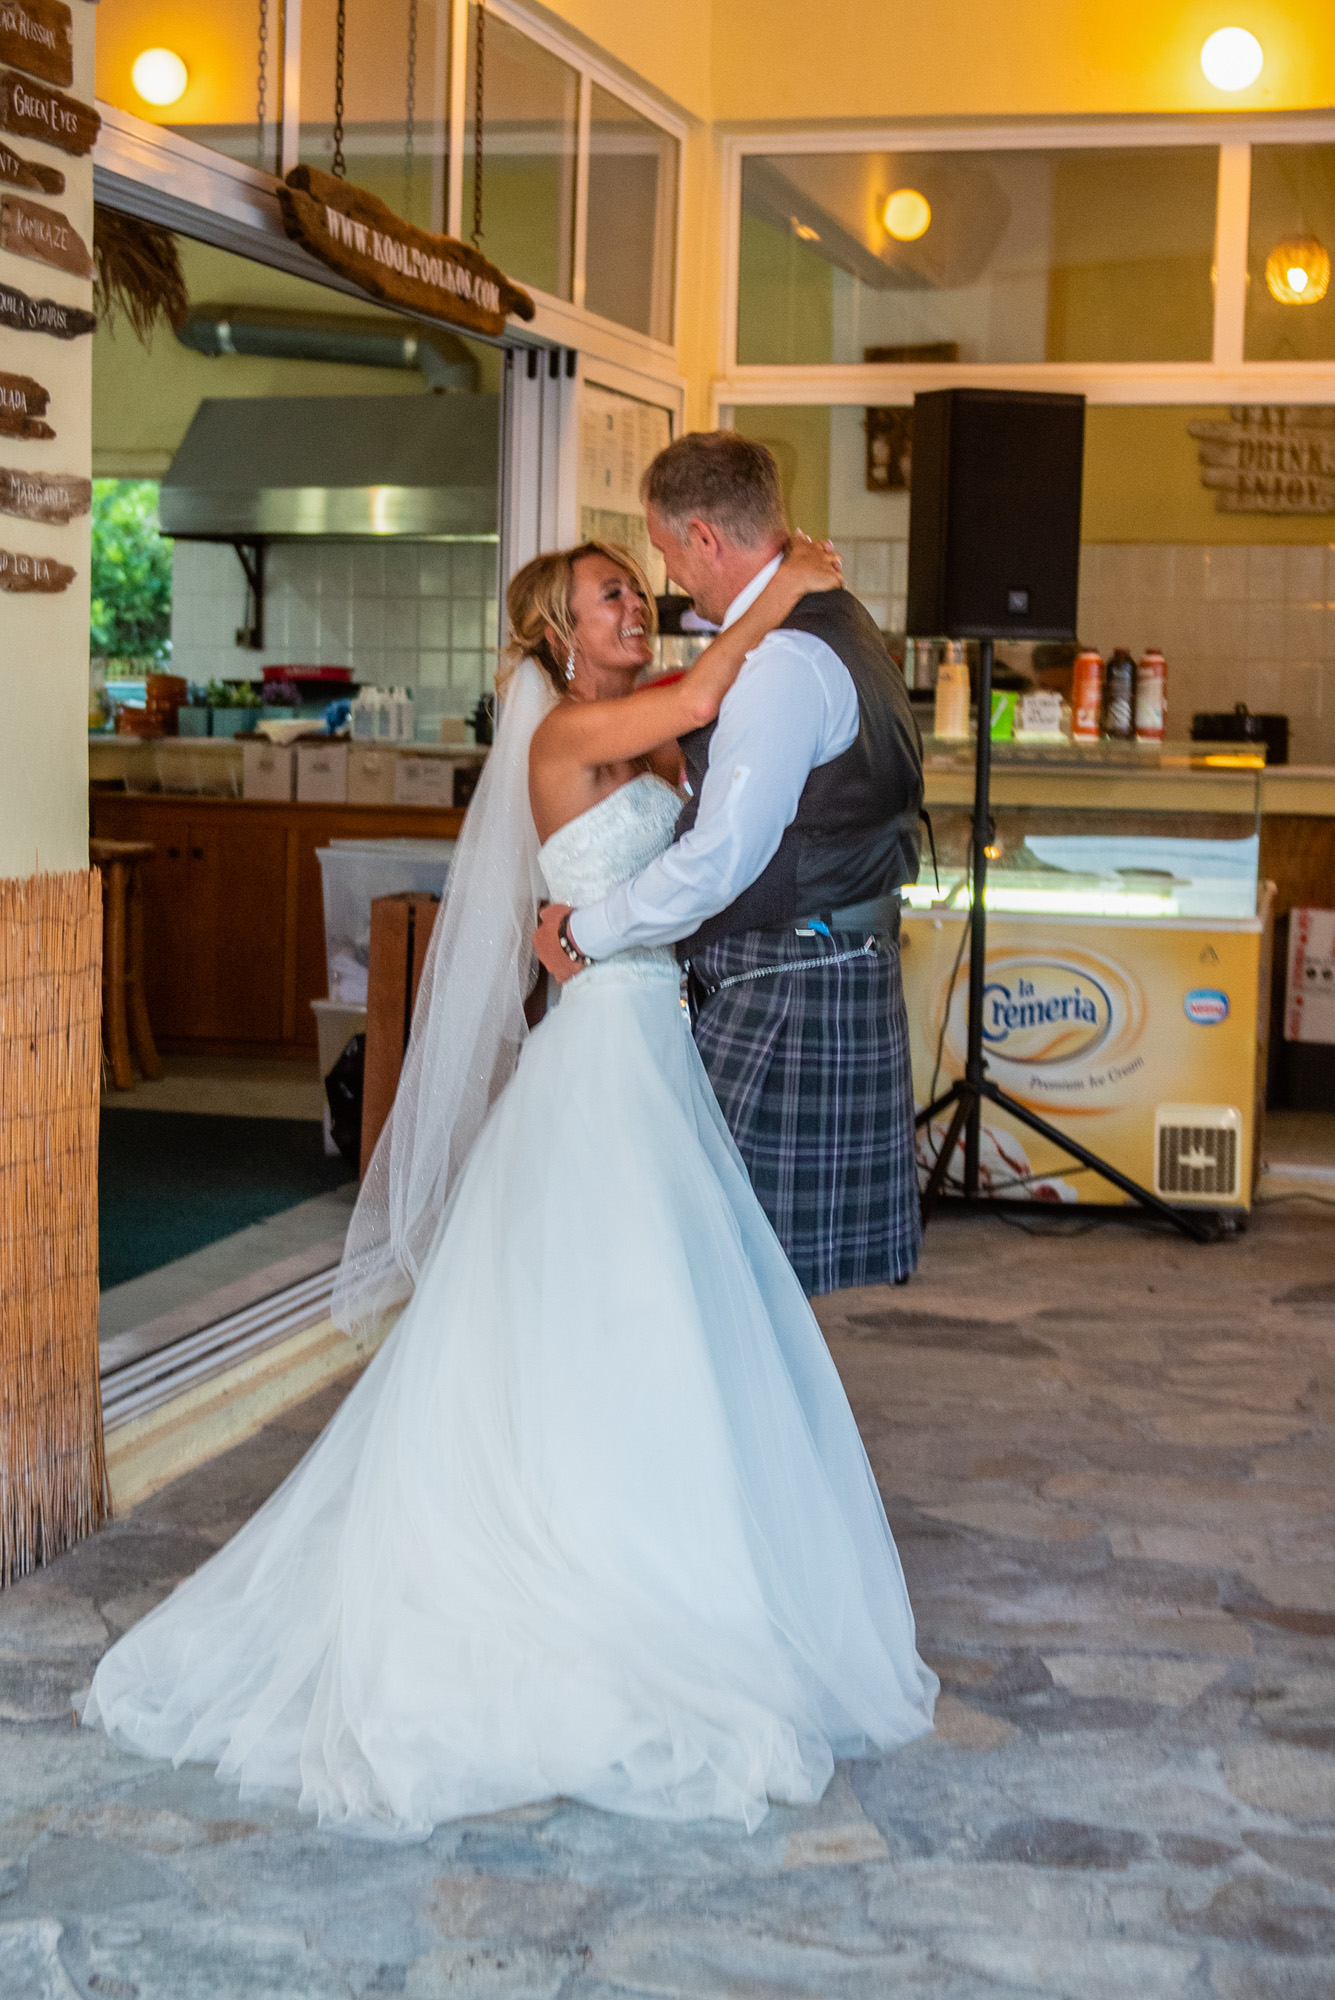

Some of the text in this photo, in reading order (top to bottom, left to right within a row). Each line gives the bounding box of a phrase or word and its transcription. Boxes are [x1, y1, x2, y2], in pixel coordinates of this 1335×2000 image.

[13, 84, 78, 133] GREEN EYES
[16, 207, 69, 251] KAMIKAZE
[10, 475, 70, 507] MARGARITA
[1018, 978, 1035, 997] la
[983, 983, 1097, 1042] Cremeria
